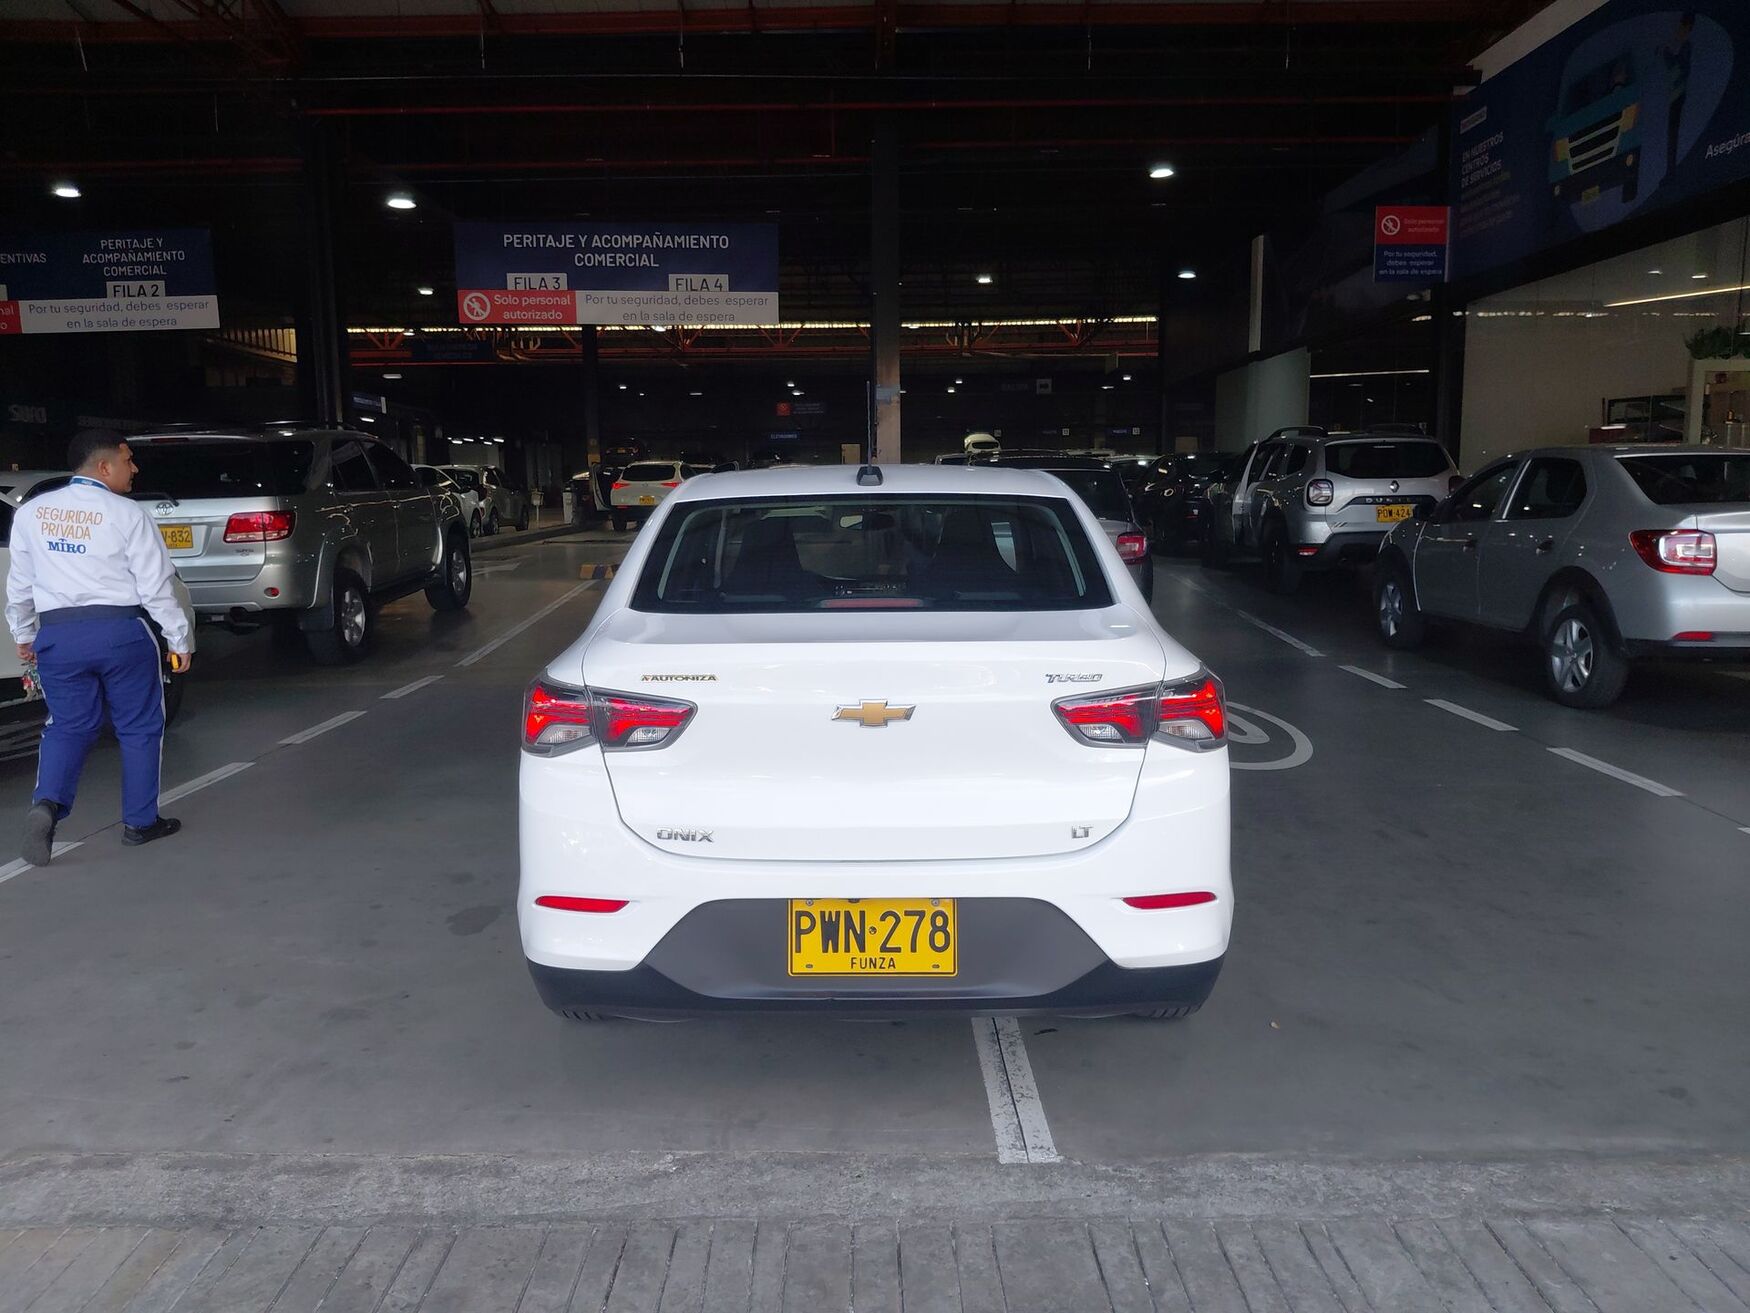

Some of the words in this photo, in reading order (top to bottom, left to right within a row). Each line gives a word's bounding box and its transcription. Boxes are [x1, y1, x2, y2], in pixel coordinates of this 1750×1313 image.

[100, 238, 154, 250] PERITAJE
[156, 237, 163, 248] Y
[503, 234, 575, 248] PERITAJE
[578, 234, 587, 248] Y
[591, 232, 729, 249] ACOMPAÑAMIENTO
[82, 250, 186, 264] ACOMPAÑAMIENTO
[574, 253, 660, 267] COMERCIAL
[103, 265, 168, 277] COMERCIAL
[514, 277, 548, 290] FILA
[552, 277, 561, 290] 3
[675, 278, 709, 291] FILA
[714, 278, 723, 291] 4
[113, 285, 147, 298] FILA
[150, 284, 159, 297] 2
[494, 294, 516, 305] Solo
[522, 294, 571, 306] personal
[585, 295, 604, 305] Por
[607, 295, 618, 305] tu
[621, 294, 682, 307] seguridad,
[684, 295, 720, 306] debes
[725, 297, 768, 308] esperar
[28, 304, 46, 314] Por
[50, 304, 61, 314] tu
[64, 301, 123, 315] seguridad,
[125, 301, 160, 312] debes
[166, 301, 209, 312] esperar
[503, 310, 563, 320] autorizado
[67, 320, 80, 329] en
[84, 318, 94, 328] la
[96, 318, 118, 328] sala
[121, 317, 135, 327] de
[139, 318, 177, 329] espera
[622, 312, 637, 321] en
[640, 311, 650, 321] la
[653, 311, 675, 321] sala
[678, 311, 693, 321] de
[696, 313, 735, 324] espera
[35, 506, 103, 526] SEGURIDAD
[41, 521, 91, 540] PRIVADA
[47, 538, 87, 554] MIRO
[656, 826, 714, 843] ONIX
[1071, 825, 1094, 839] LT
[850, 957, 896, 969] FUNZA
